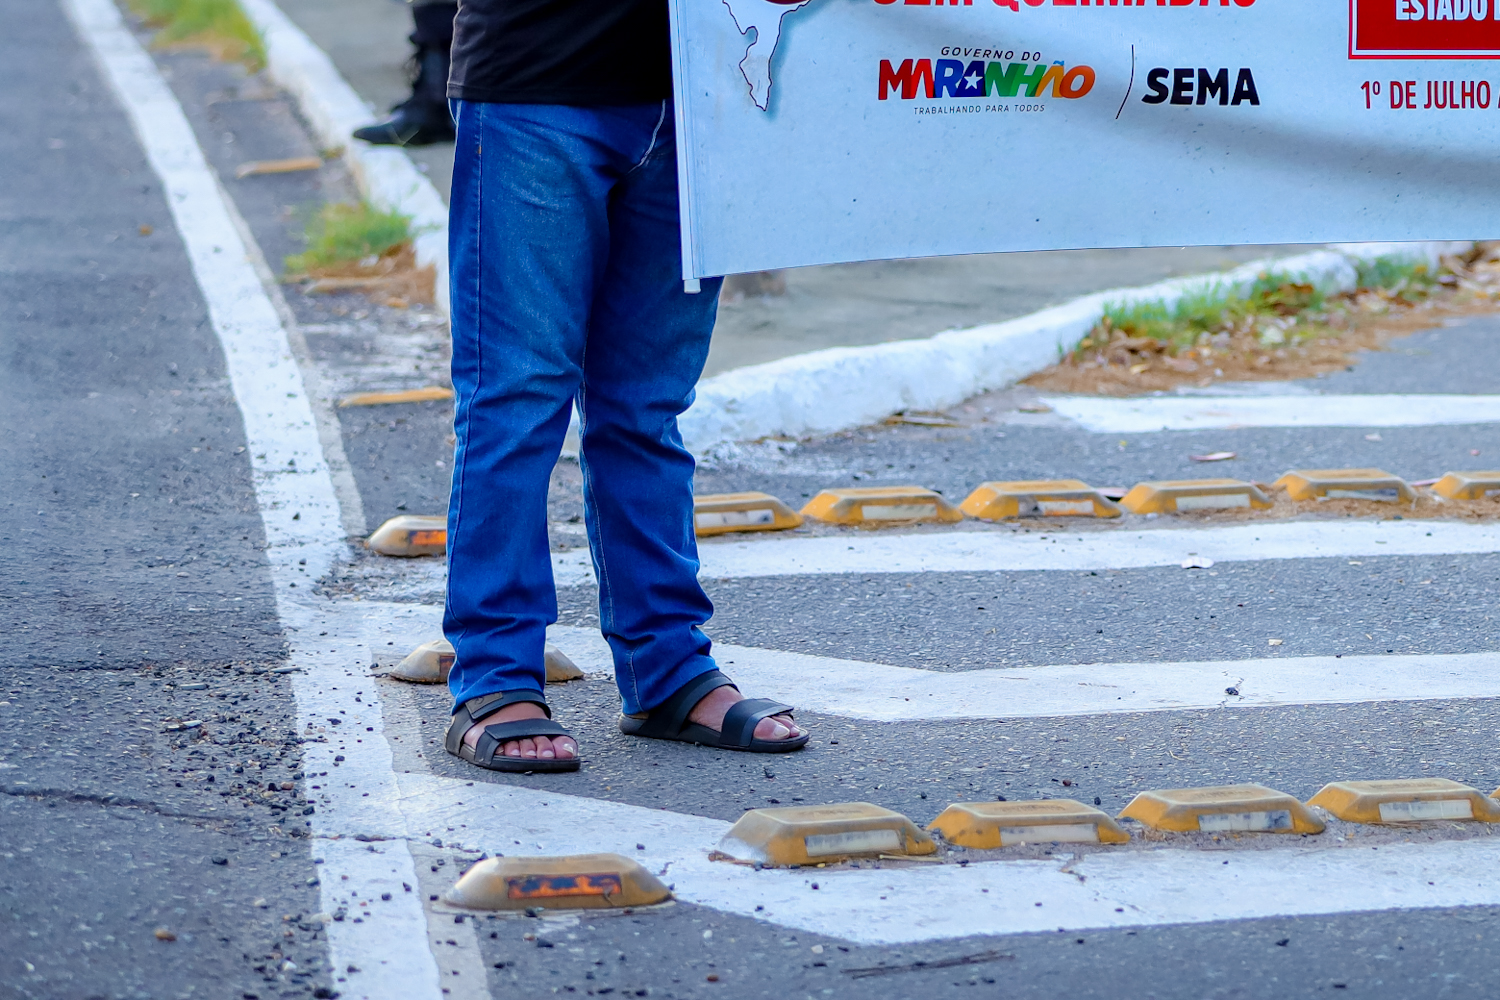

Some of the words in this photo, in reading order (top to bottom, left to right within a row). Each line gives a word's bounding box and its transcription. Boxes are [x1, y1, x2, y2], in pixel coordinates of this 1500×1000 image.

[940, 46, 1014, 60] GOVERNO
[1021, 50, 1042, 62] DO
[877, 58, 1095, 100] MARANHÃO
[1141, 67, 1261, 107] SEMA
[1360, 80, 1381, 109] 1º
[1389, 81, 1417, 109] DE
[1424, 80, 1491, 109] JULHO
[913, 105, 982, 116] TRABALHANDO
[985, 104, 1010, 114] PARA
[1013, 103, 1046, 113] TODOS
